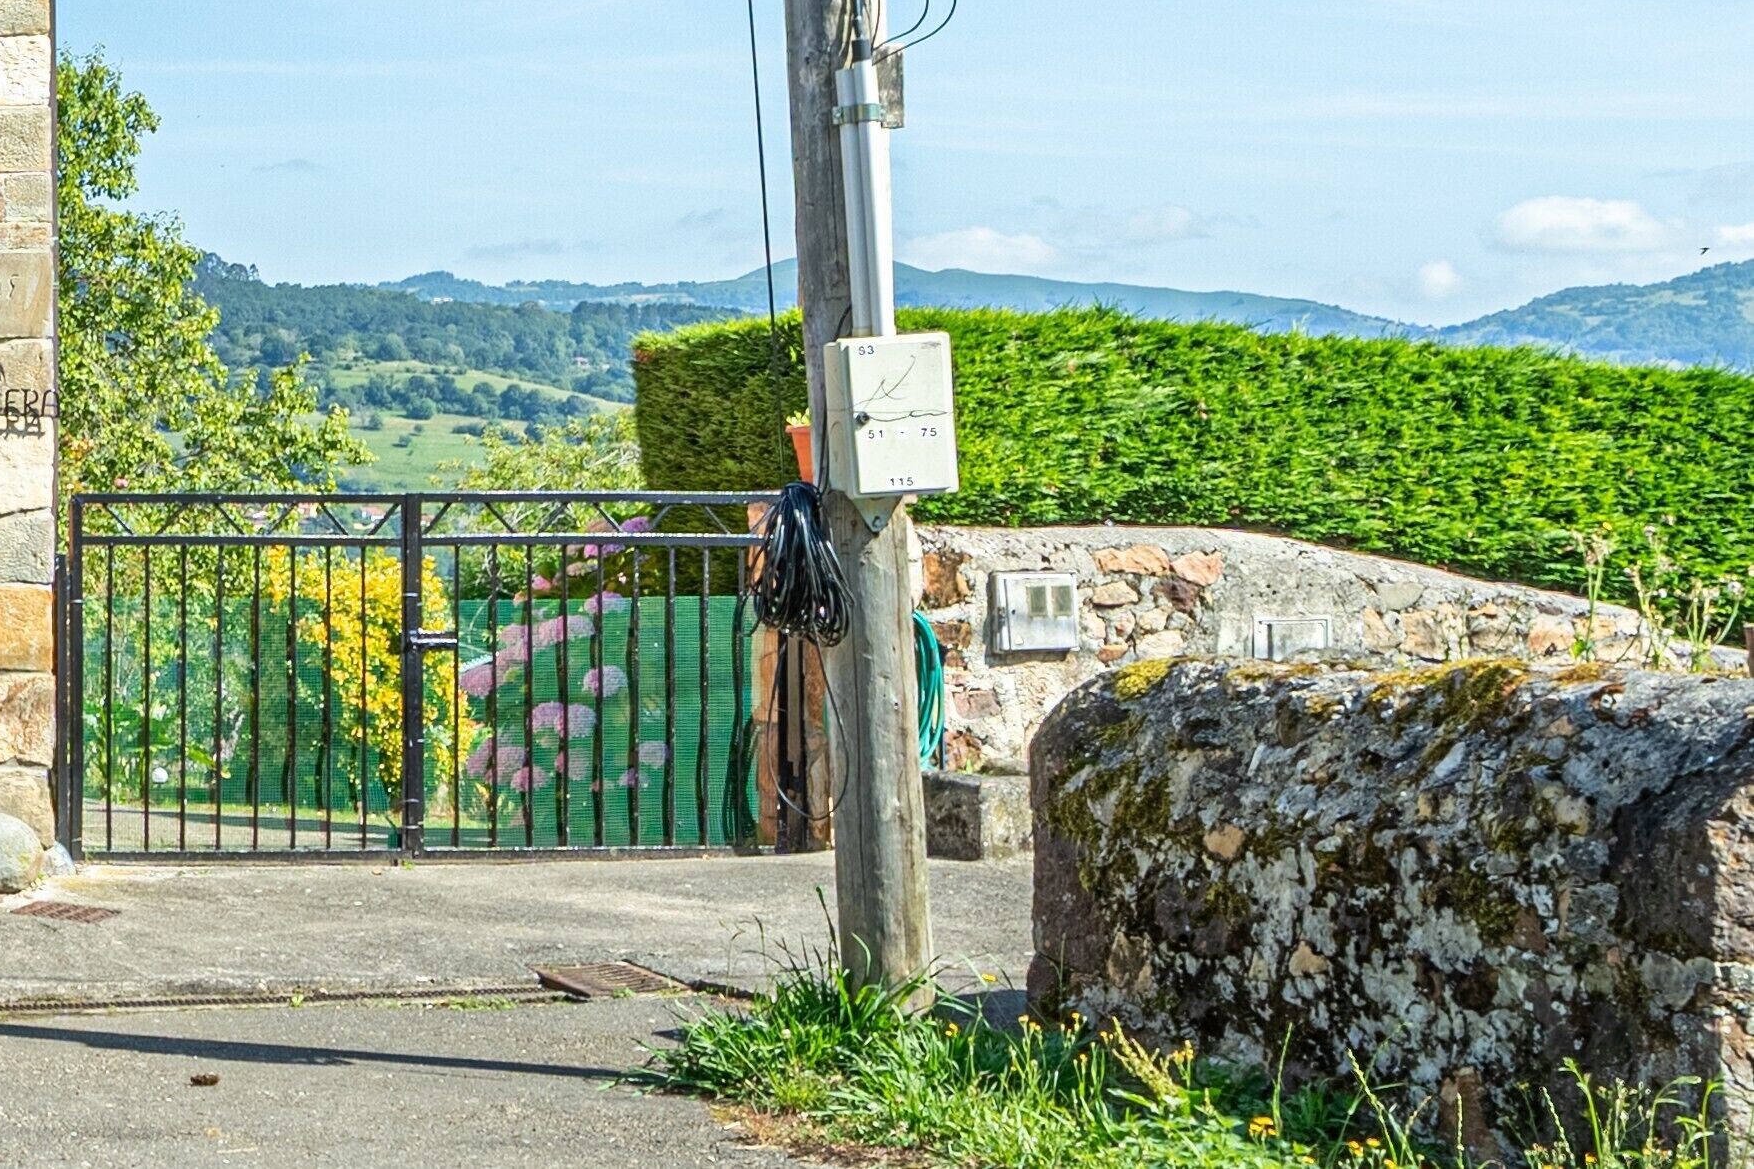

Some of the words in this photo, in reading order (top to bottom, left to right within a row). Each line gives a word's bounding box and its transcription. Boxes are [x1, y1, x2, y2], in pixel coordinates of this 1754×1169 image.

[868, 430, 883, 439] 51
[921, 427, 937, 437] 75
[890, 478, 914, 486] 115
